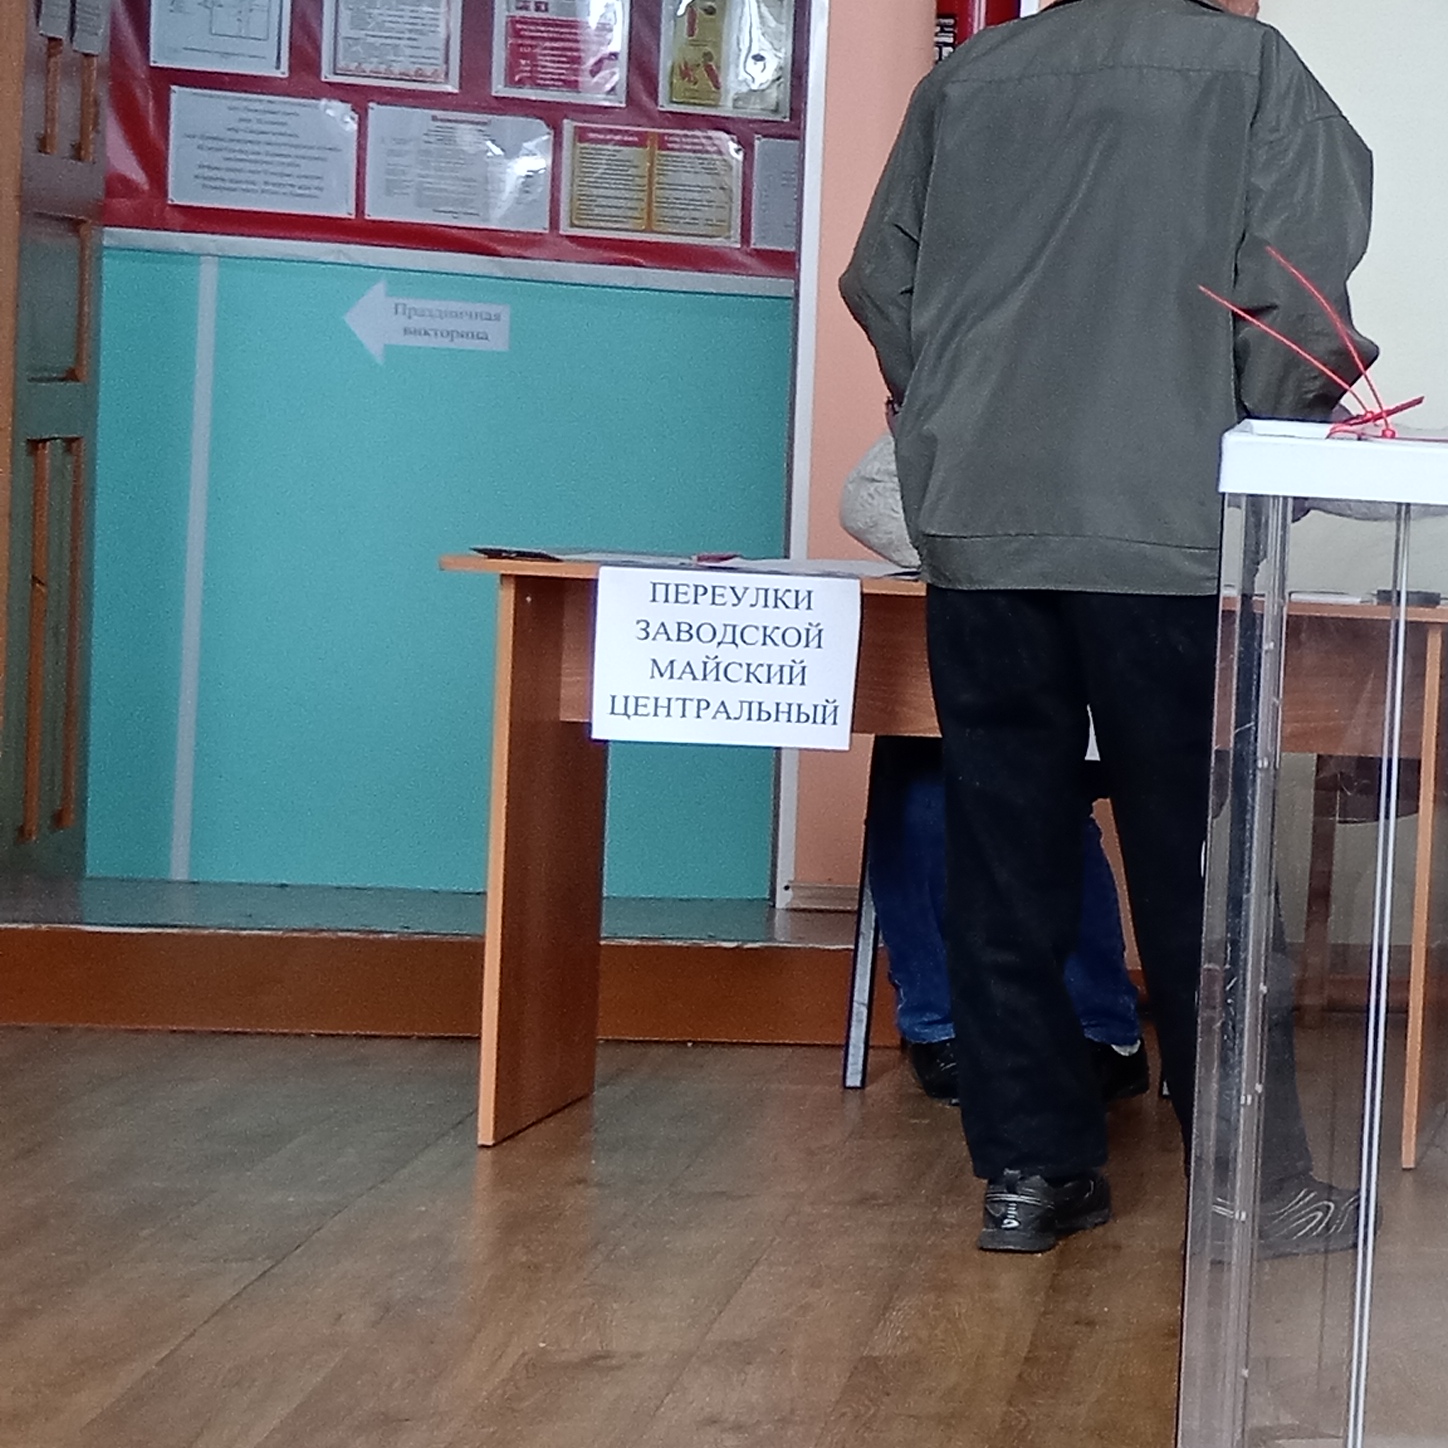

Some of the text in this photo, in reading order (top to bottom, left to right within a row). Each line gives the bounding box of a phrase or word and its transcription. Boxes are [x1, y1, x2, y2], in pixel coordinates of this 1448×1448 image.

[394, 302, 502, 322] Праздничная
[403, 325, 490, 342] викторина
[649, 581, 814, 611] ПЕРЕУЛКИ
[635, 618, 824, 650] ЗАВОДСКОЙ
[649, 654, 808, 687] МАЙСКИЙ
[608, 693, 840, 726] ЦЕНТРАЛЬНЫЙ
